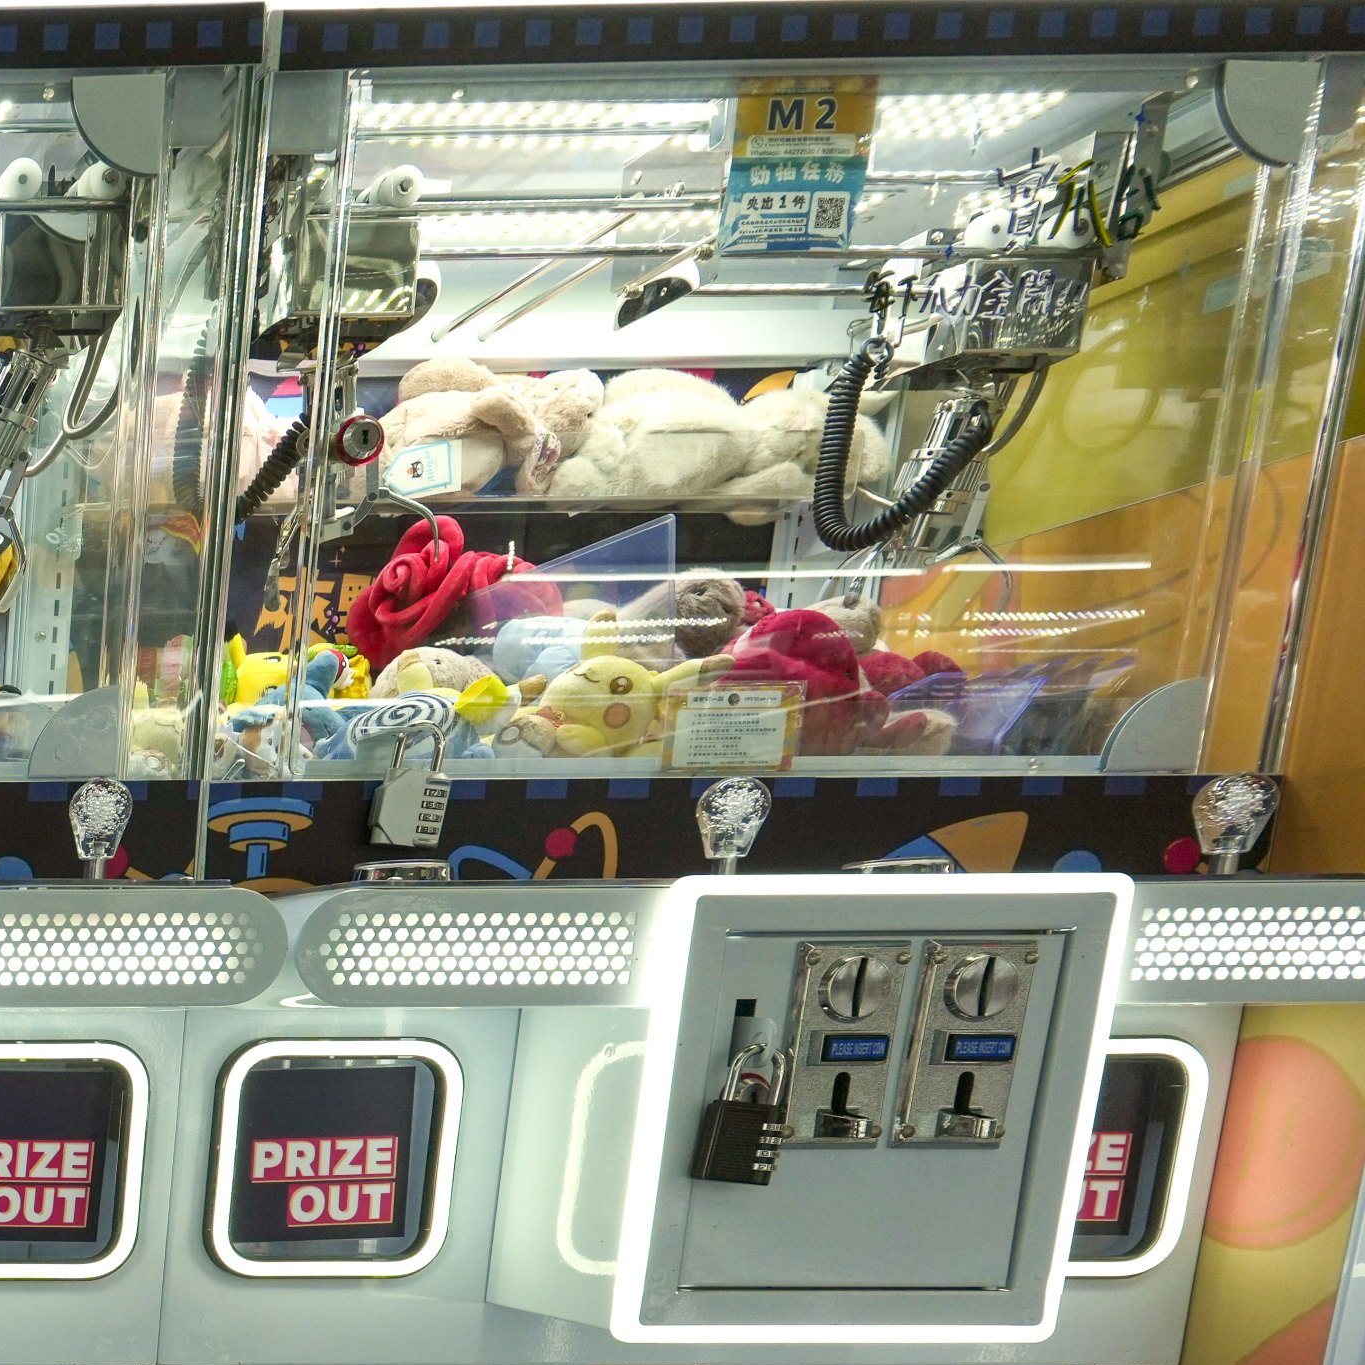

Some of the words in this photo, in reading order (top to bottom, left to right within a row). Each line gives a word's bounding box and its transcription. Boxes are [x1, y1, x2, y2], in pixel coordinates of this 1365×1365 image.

[832, 1042, 854, 1055] PLEASE
[854, 1042, 871, 1055] INSERT
[872, 1042, 886, 1055] COIN
[958, 1041, 979, 1054] PLEASE
[980, 1041, 998, 1054] INSERT
[998, 1041, 1013, 1054] COIN
[253, 1137, 393, 1178] PRIZE
[290, 1183, 391, 1223] OUT
